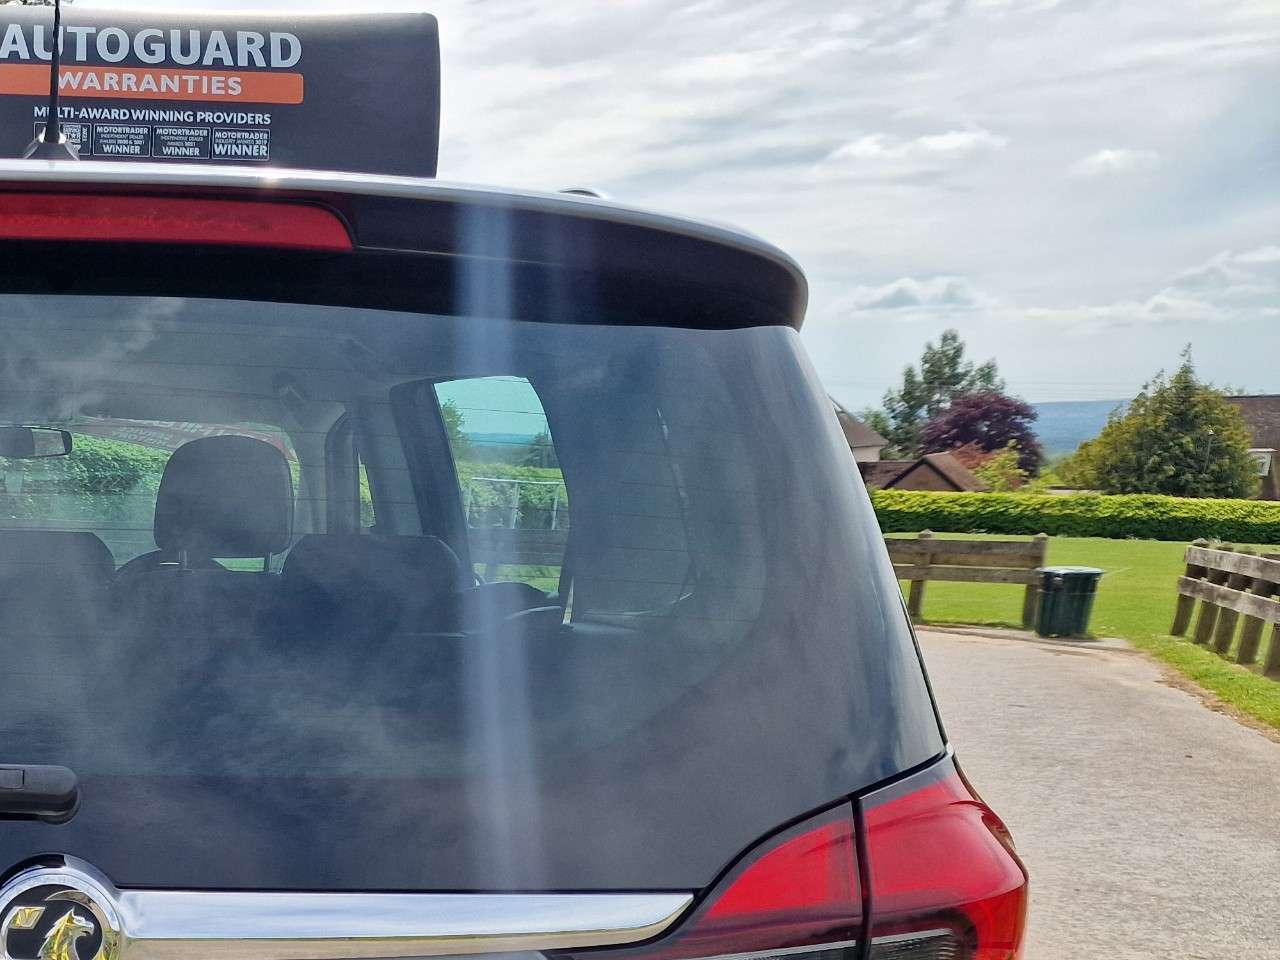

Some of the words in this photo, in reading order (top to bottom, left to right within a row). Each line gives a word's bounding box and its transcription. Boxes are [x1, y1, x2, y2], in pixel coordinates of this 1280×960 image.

[58, 71, 243, 96] WARRANTIES
[34, 106, 129, 120] MLTI-AWARD
[131, 109, 194, 122] WINNING
[197, 111, 271, 125] PROVIDERS
[156, 128, 208, 136] MOTORTRADER
[215, 132, 268, 140] MOTORTRADER
[102, 144, 141, 154] WINNER
[162, 146, 200, 156] WINNER
[214, 144, 268, 156] WINNER
